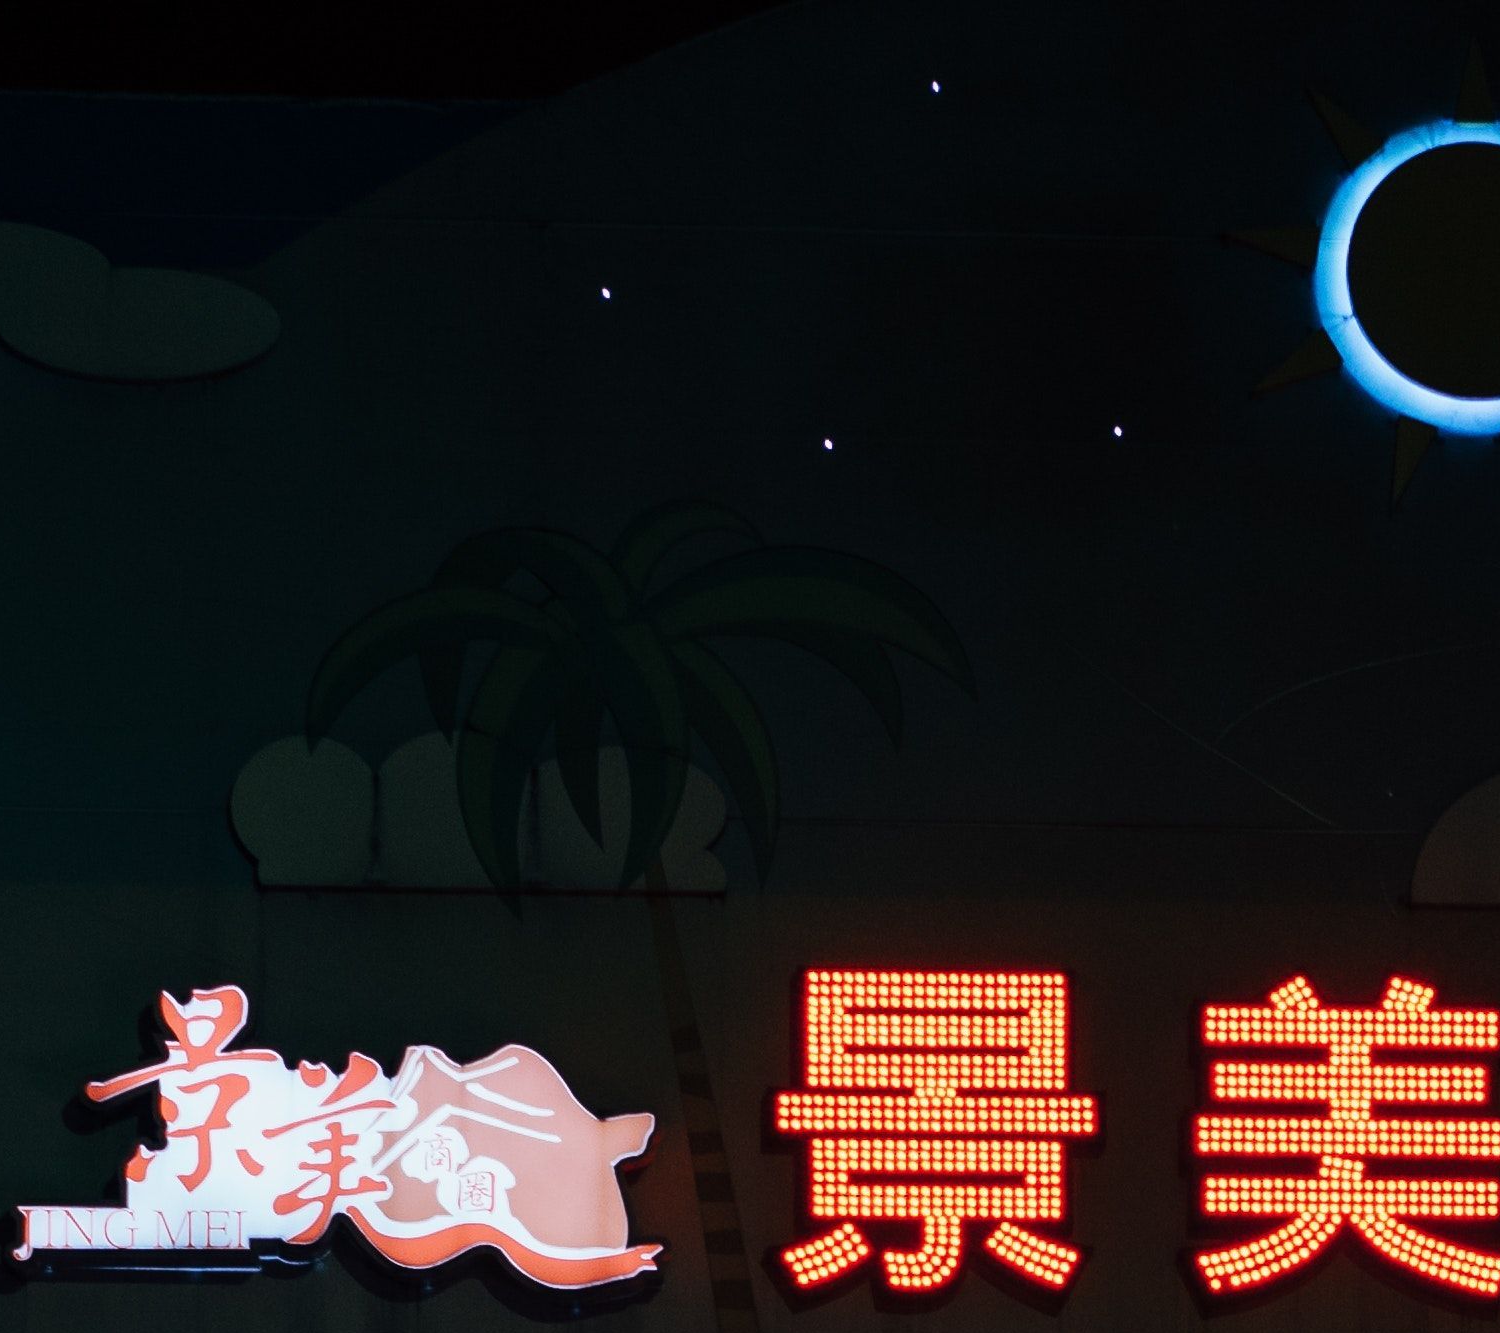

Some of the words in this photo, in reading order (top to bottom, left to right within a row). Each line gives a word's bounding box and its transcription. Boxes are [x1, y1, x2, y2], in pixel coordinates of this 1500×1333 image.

[84, 984, 400, 1245] 景美
[415, 1133, 497, 1215] 商圈
[14, 1207, 137, 1260] JING
[156, 1209, 248, 1250] MEI
